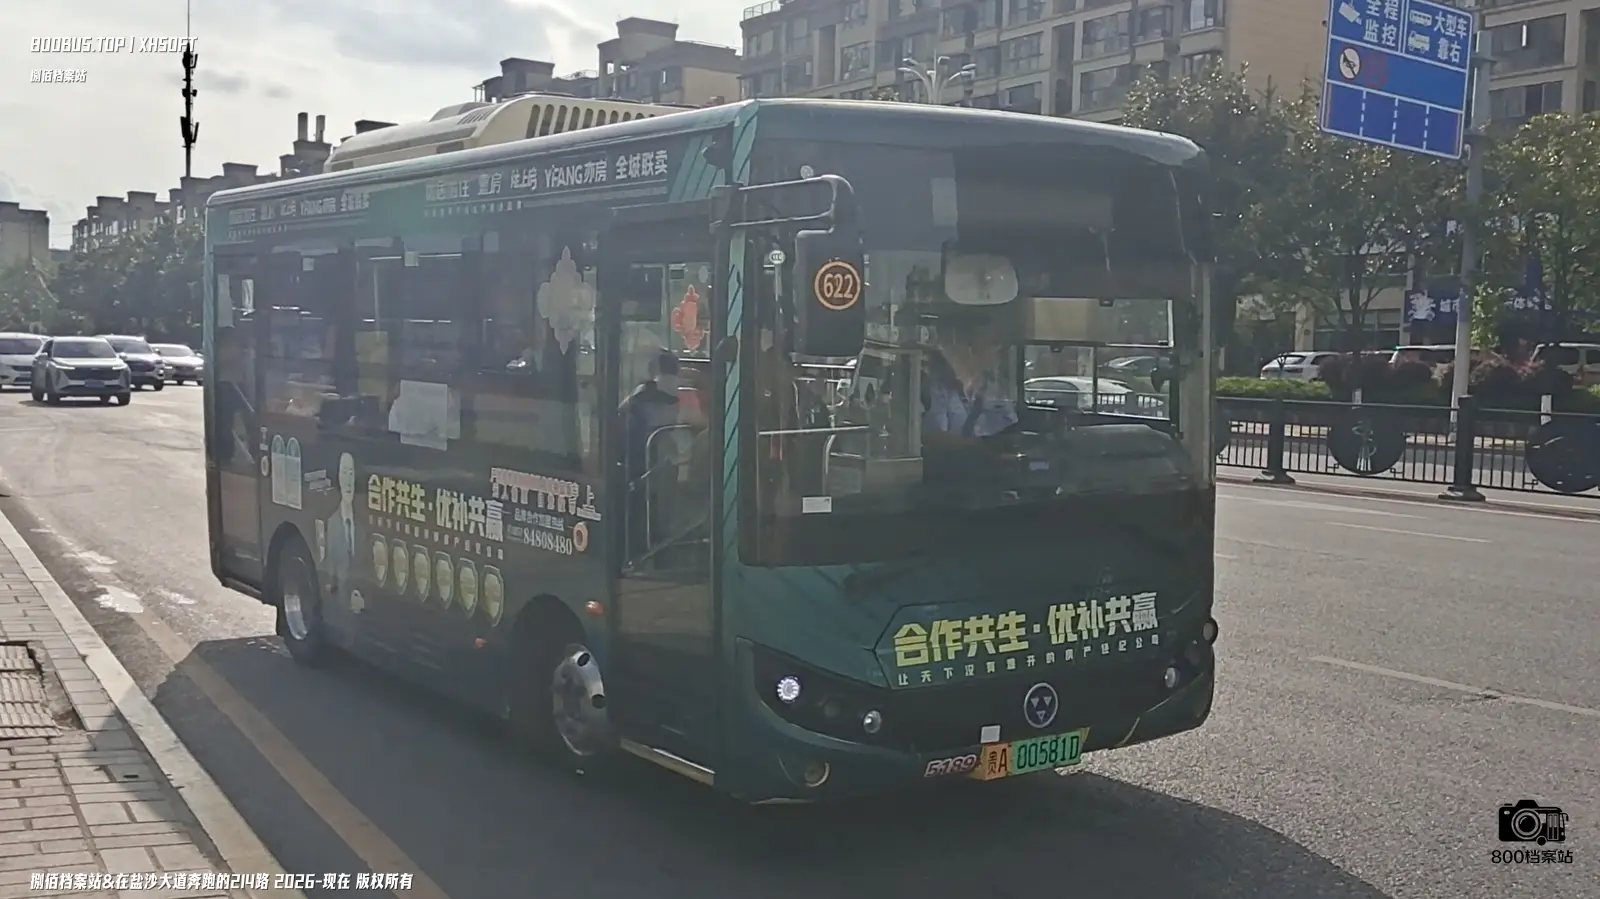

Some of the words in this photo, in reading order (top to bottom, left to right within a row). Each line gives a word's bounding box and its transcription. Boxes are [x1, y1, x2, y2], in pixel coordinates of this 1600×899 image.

[1363, 18, 1398, 47] 监控
[1433, 11, 1468, 39] 大型车
[1437, 37, 1462, 63] 靠右
[615, 149, 668, 180] 全城联卖
[823, 273, 853, 299] 622
[1016, 735, 1080, 770] 00581D
